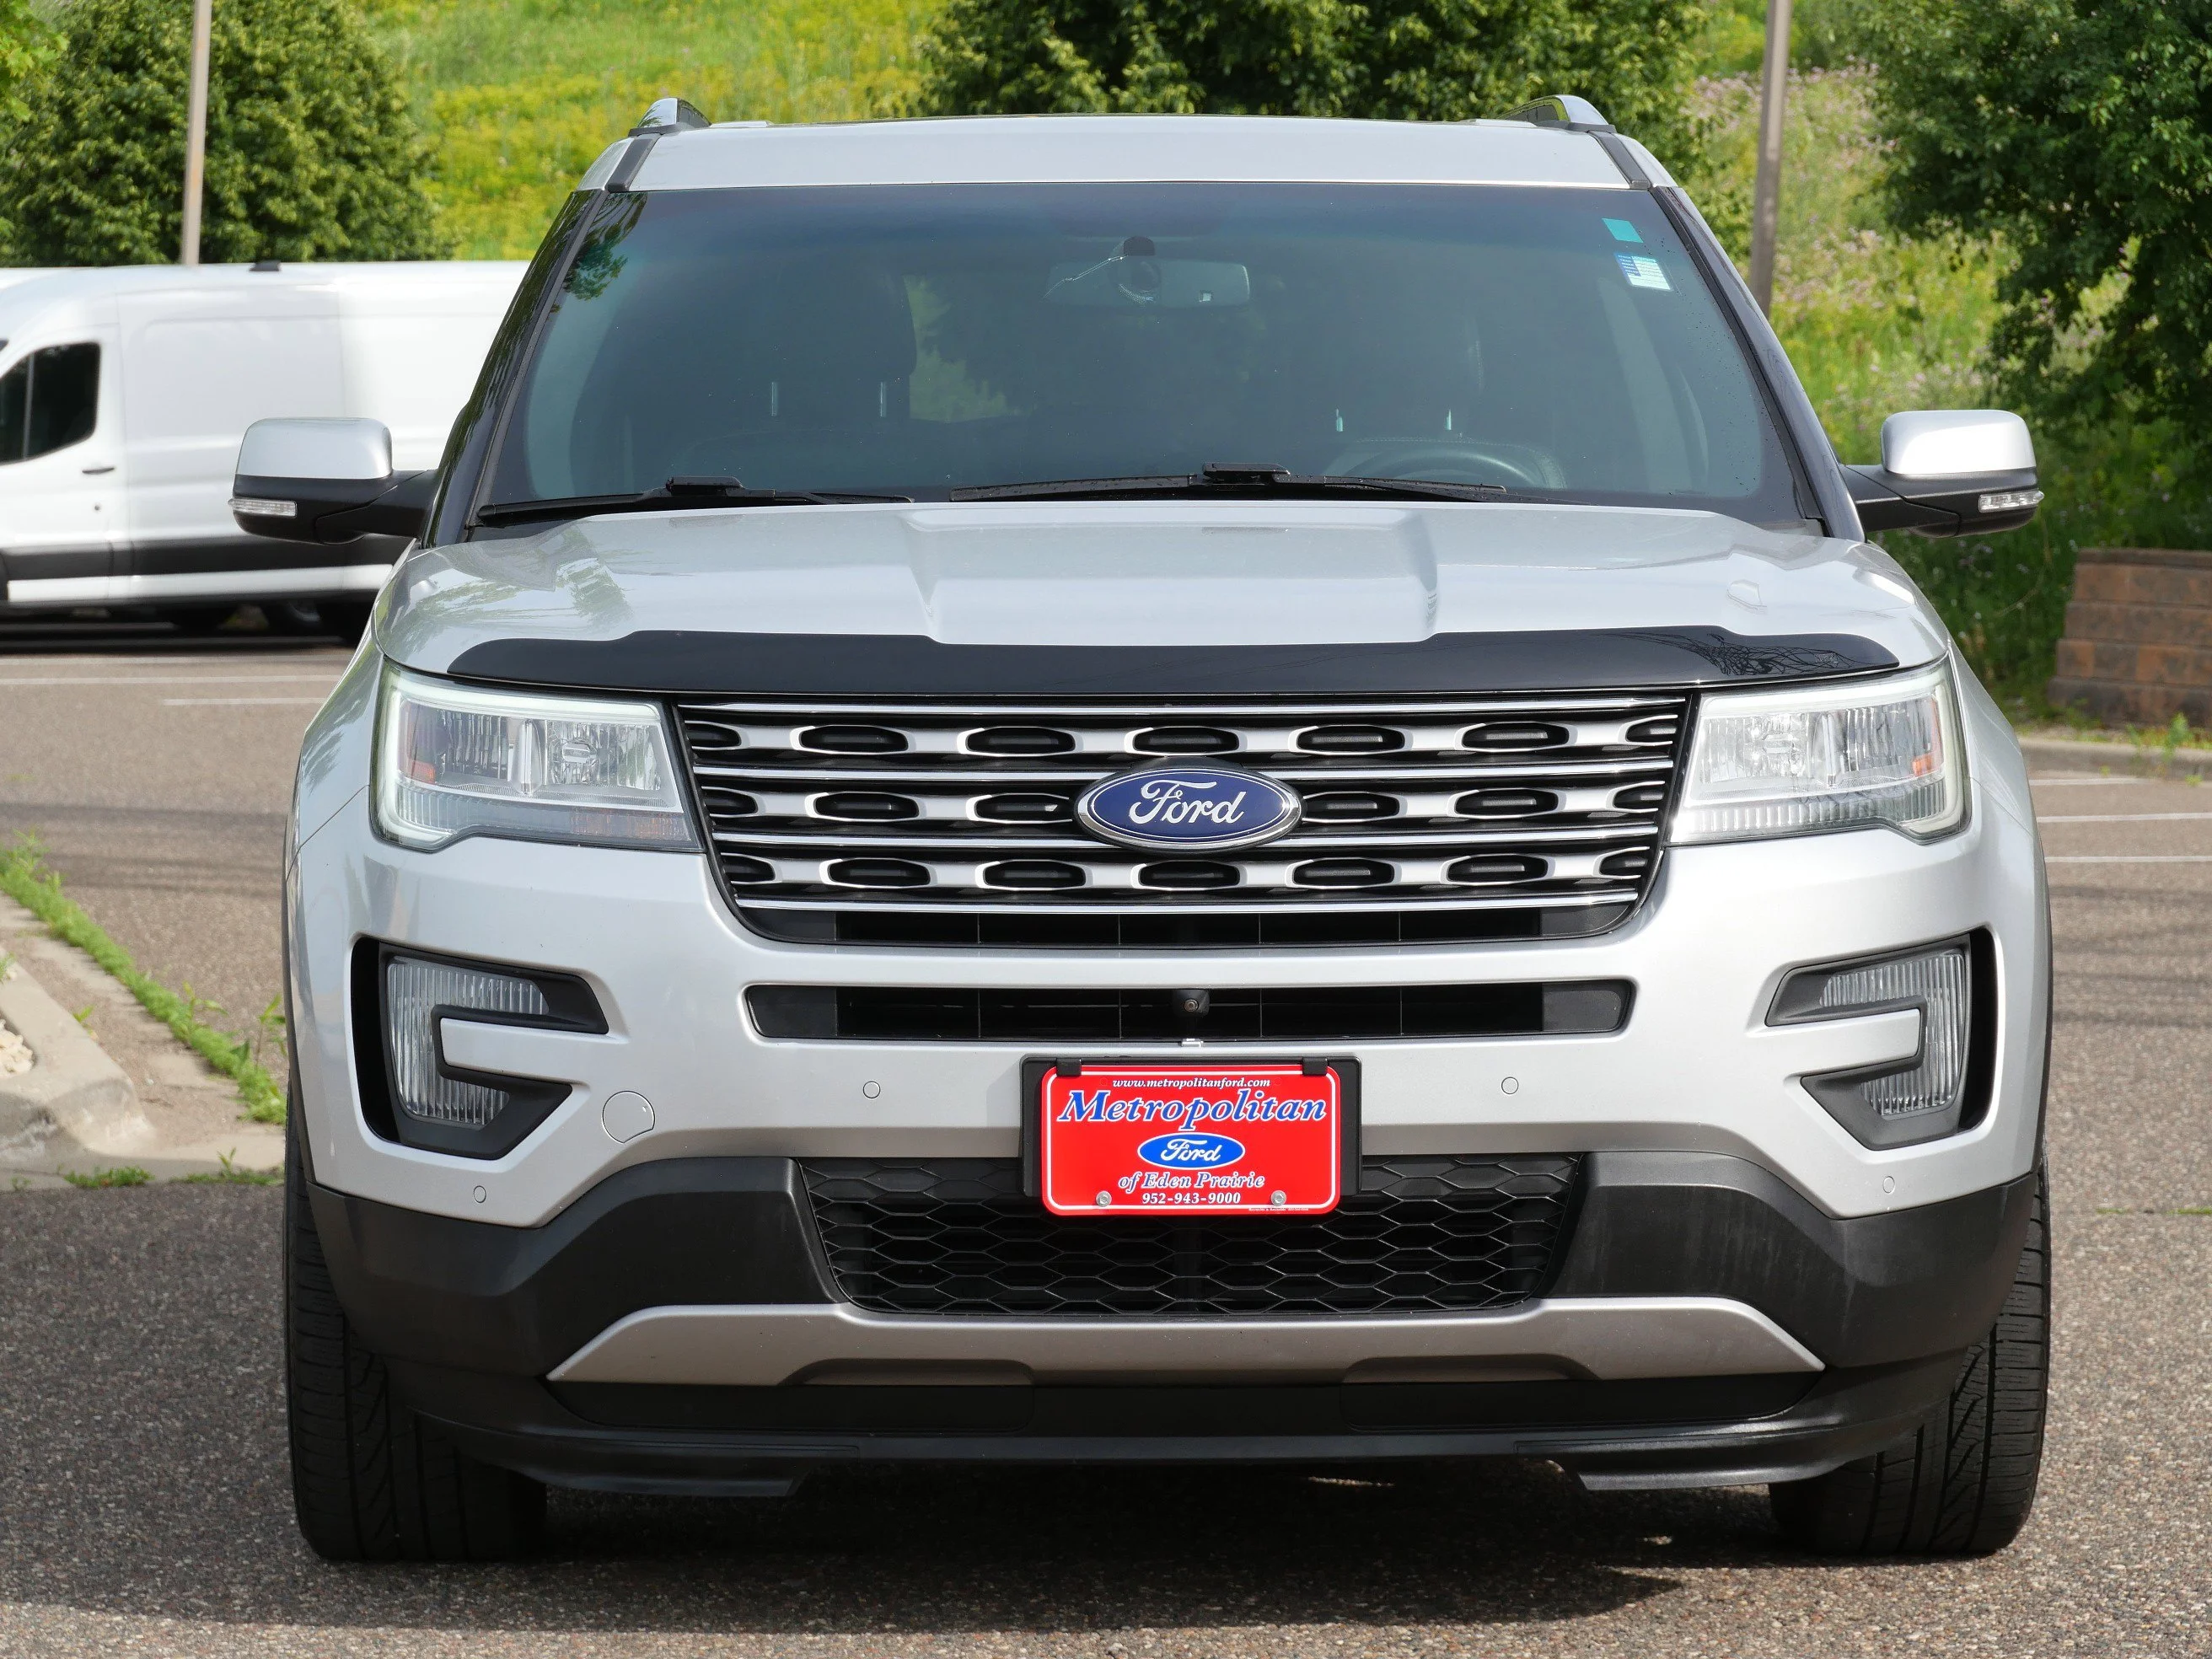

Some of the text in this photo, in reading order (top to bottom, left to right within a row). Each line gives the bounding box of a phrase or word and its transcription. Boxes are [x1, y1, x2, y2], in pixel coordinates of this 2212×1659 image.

[1129, 779, 1247, 824] Ford
[1112, 1077, 1271, 1089] www.metropolitanford.com
[1056, 1088, 1327, 1131] Metropolitan
[1160, 1138, 1221, 1162] Ford
[1118, 1171, 1266, 1194] of Eden Prairie
[1141, 1192, 1242, 1205] 952-943-9000
